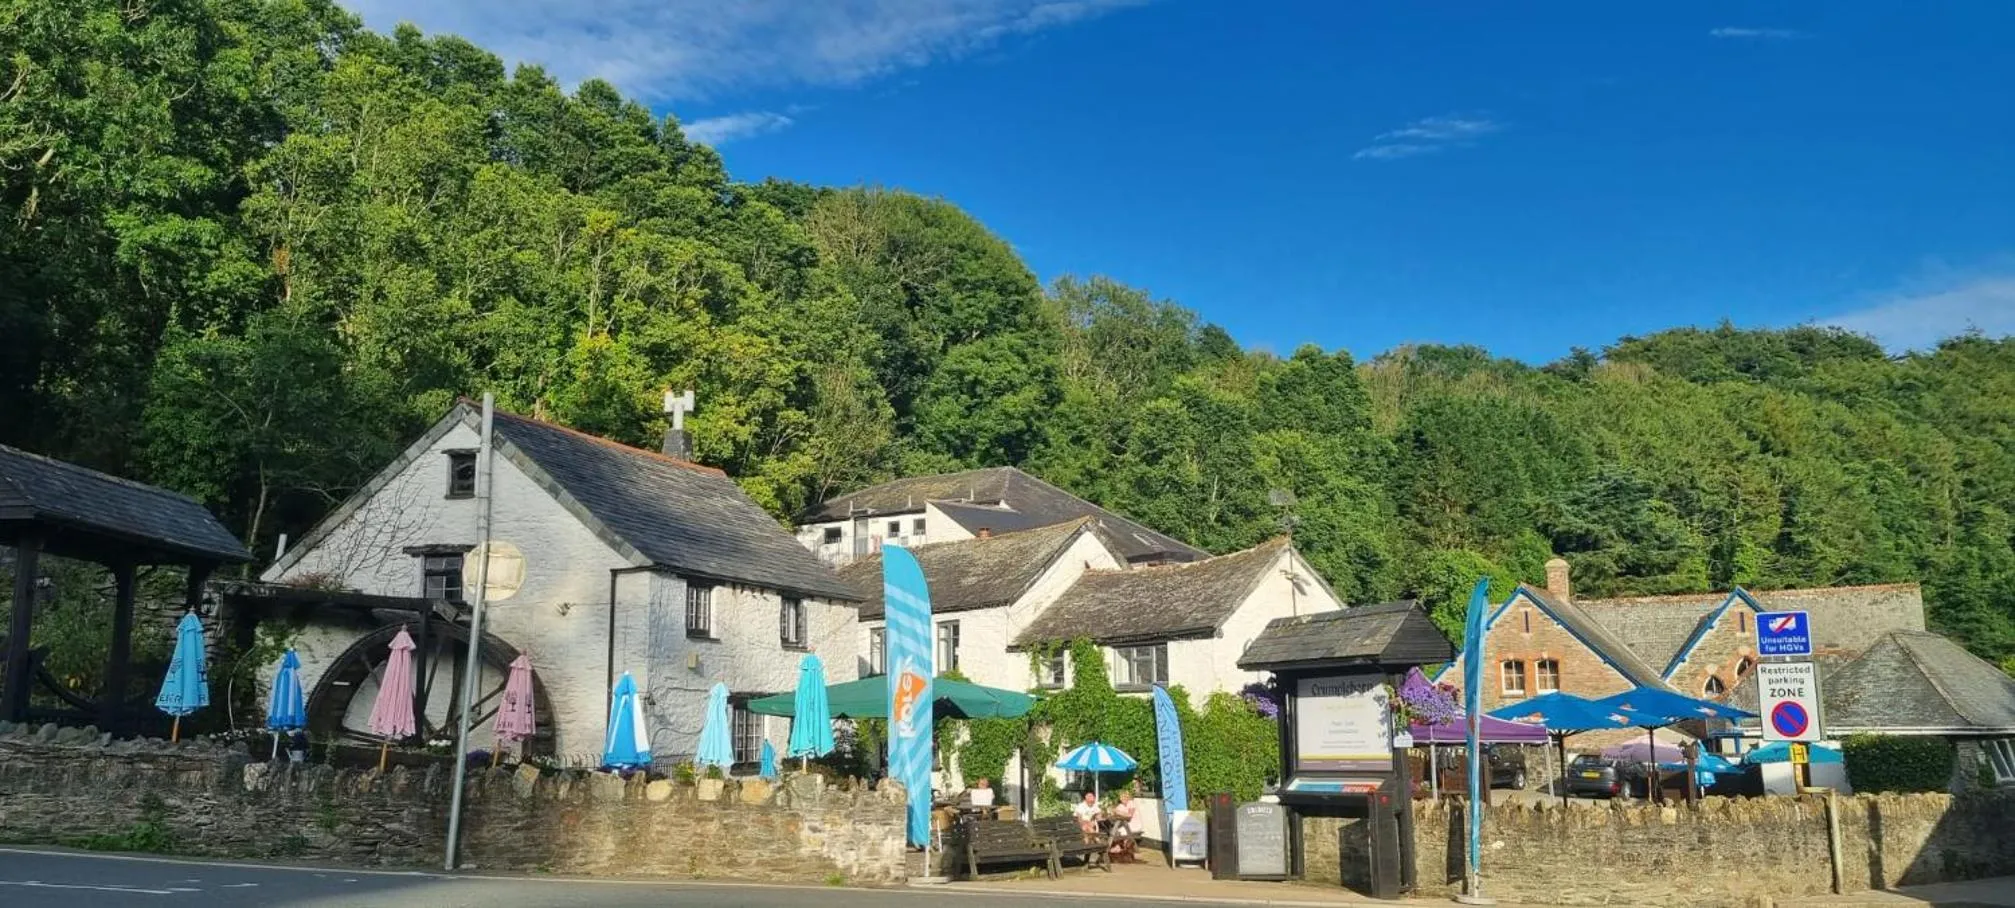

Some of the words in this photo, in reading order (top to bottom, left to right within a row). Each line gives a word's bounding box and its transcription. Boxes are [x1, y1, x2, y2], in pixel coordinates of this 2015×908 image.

[1760, 636, 1807, 644] Unsuitable
[1765, 644, 1777, 652] for
[1779, 643, 1804, 652] HGVs
[1760, 666, 1811, 674] Restricted
[1769, 677, 1805, 685] parking
[1769, 688, 1805, 698] ZONE
